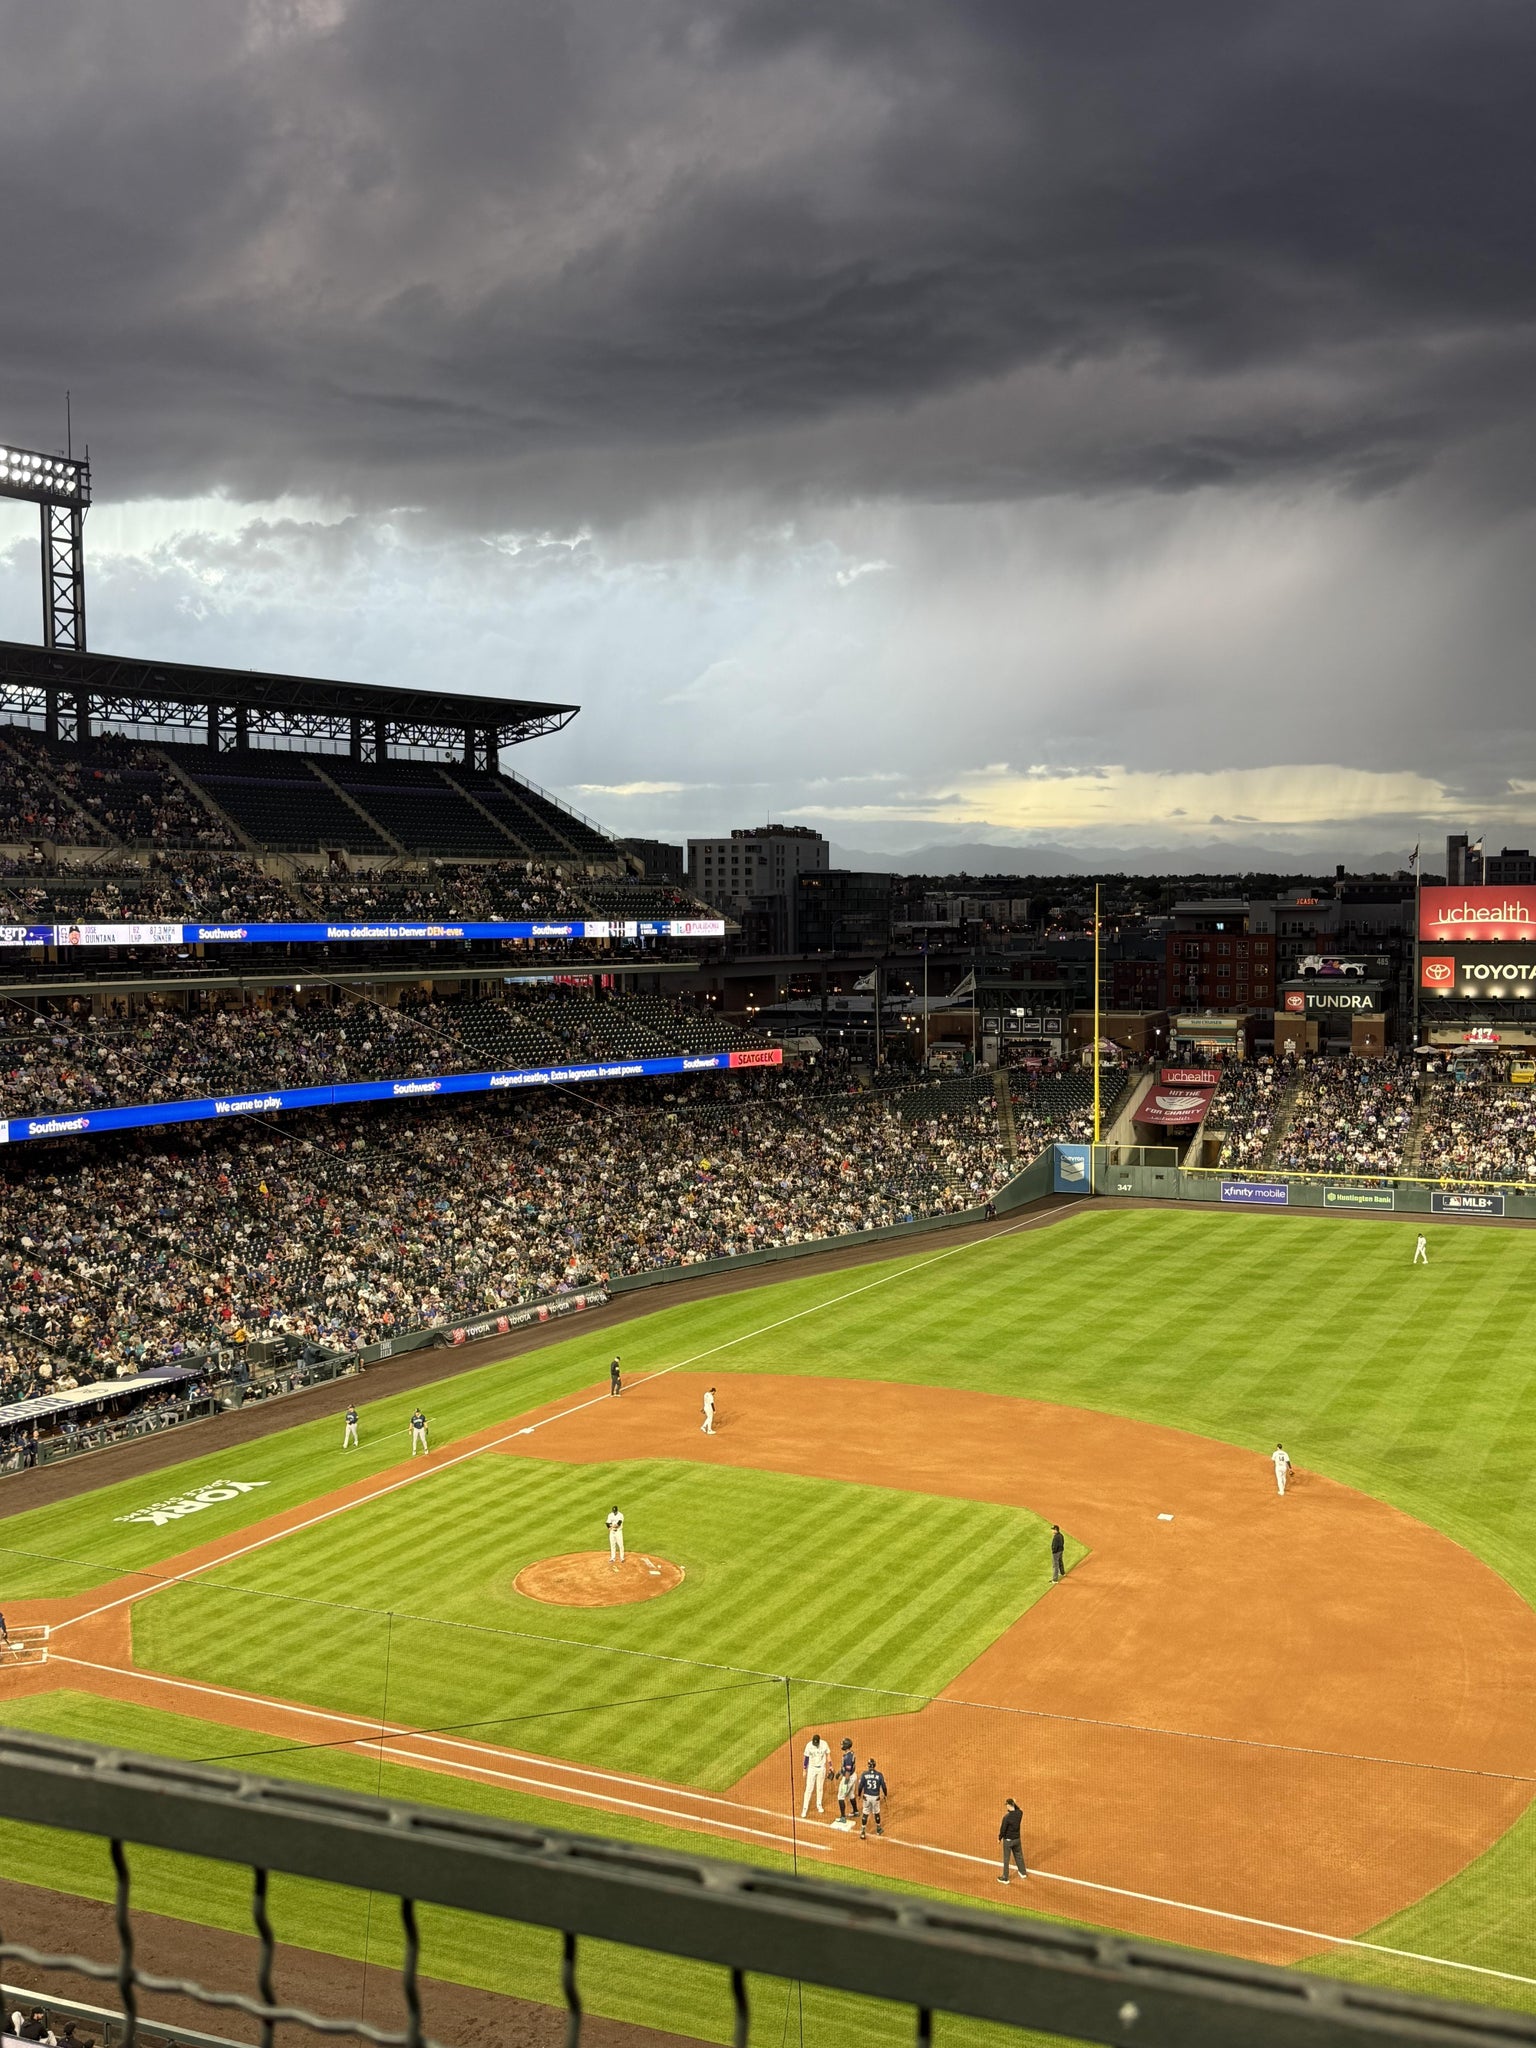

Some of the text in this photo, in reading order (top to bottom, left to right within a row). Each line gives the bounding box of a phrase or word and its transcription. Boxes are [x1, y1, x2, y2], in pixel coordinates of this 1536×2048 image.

[1439, 901, 1529, 922] uchealth
[198, 928, 242, 940] Southwest
[327, 927, 350, 938] More
[351, 927, 389, 938] dedicated
[390, 927, 399, 937] to
[400, 926, 427, 937] Denver
[532, 925, 568, 936] Southwest
[85, 934, 116, 943] QUINTANA
[1306, 995, 1374, 1008] TUNDRA
[683, 1058, 715, 1069] Southwest
[738, 1051, 774, 1065] SEATGEEK
[490, 1065, 643, 1087] Assigned seating. Extra legroom. In-seat power.
[1168, 1070, 1215, 1082] uchealth
[393, 1081, 435, 1095] Southwest
[215, 1096, 283, 1113] We came to play.
[29, 1117, 83, 1135] Southwest
[1224, 1185, 1286, 1199] xfinity mobile
[1336, 1193, 1391, 1203] Huntington Bank
[1462, 1197, 1493, 1208] MLB+
[509, 1313, 531, 1325] TOYOTA
[466, 1324, 490, 1336] TOYOTA
[112, 1479, 231, 1522] SPACE SYSTEMS
[129, 1481, 271, 1526] YORK
[867, 1780, 877, 1789] 53
